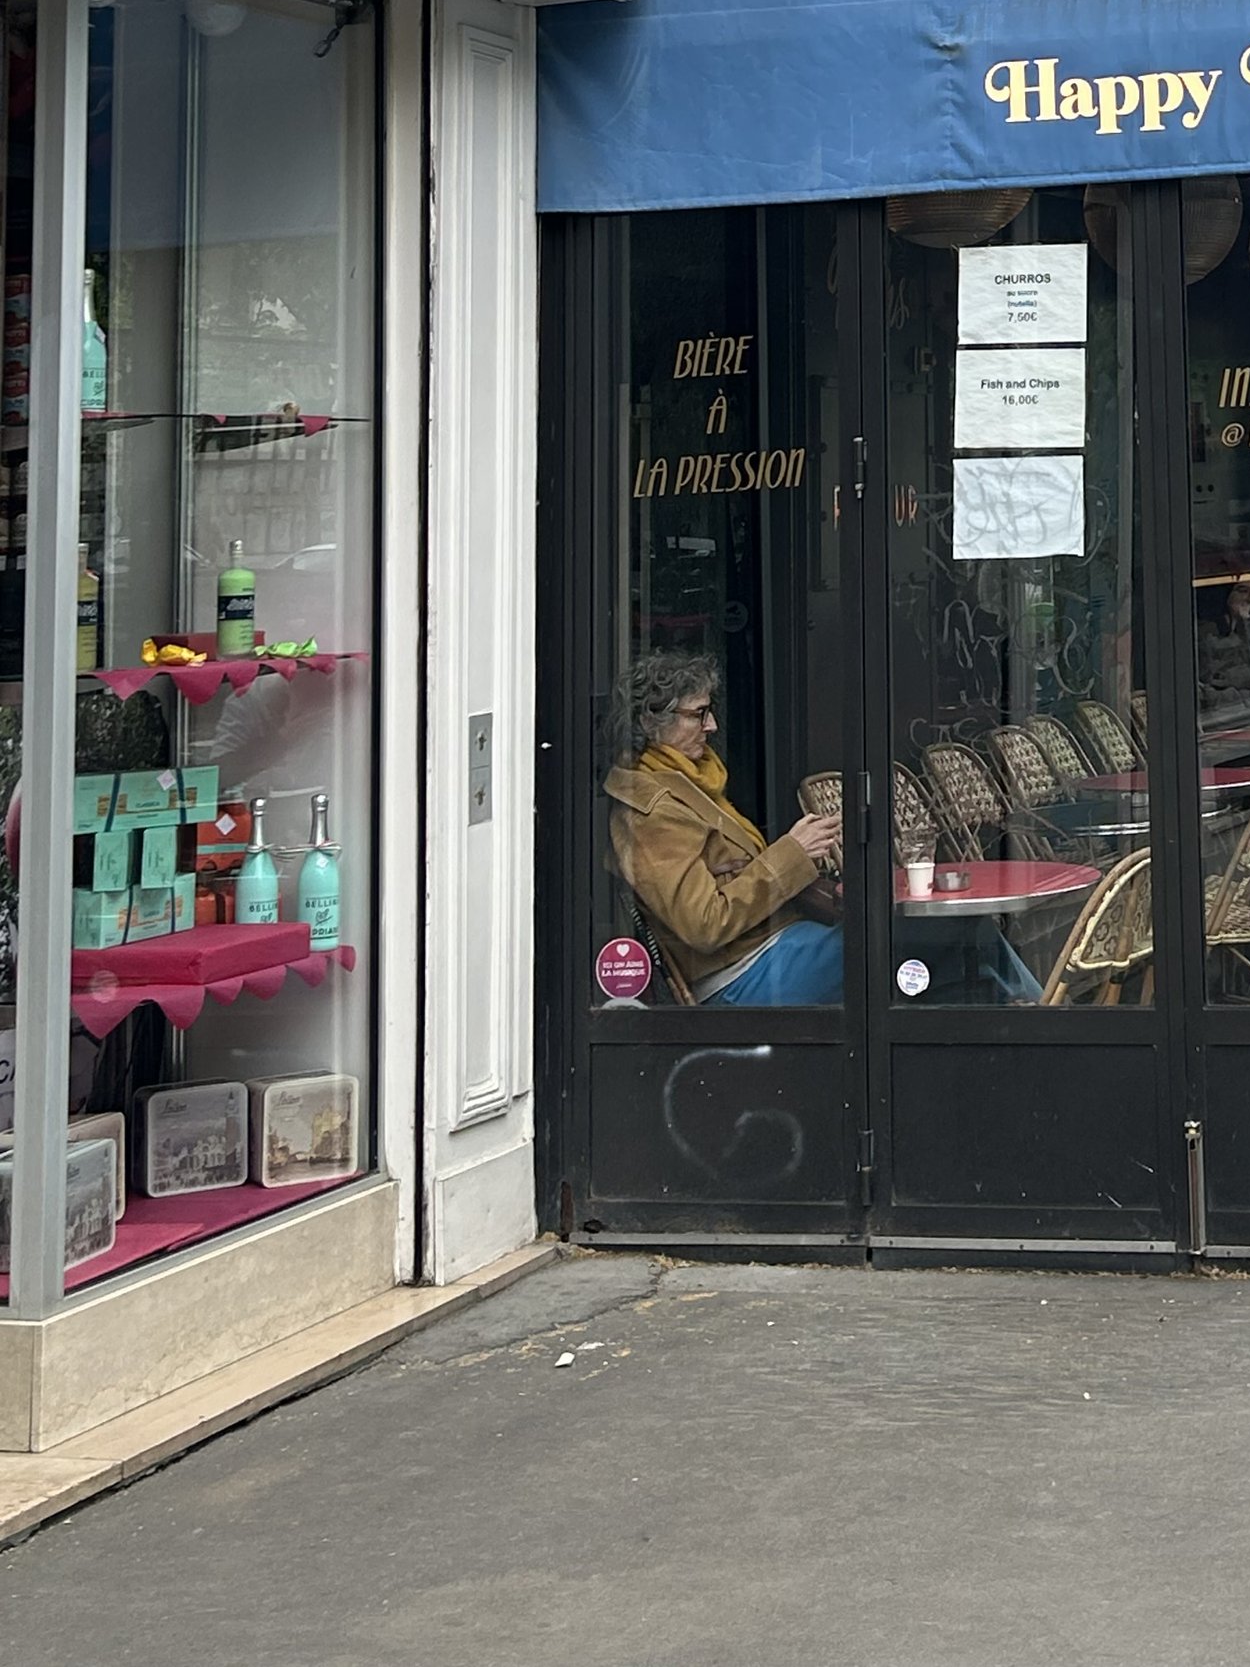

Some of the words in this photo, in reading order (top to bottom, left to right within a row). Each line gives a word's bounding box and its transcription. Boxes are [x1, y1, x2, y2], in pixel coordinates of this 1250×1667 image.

[984, 57, 1223, 135] Happy
[994, 272, 1052, 285] CHURROS
[1007, 311, 1038, 324] 7,50€
[673, 331, 754, 379] BIÈRE
[980, 379, 1004, 390] Fish
[1005, 379, 1027, 389] and
[1028, 378, 1061, 391] Chips
[706, 387, 728, 435] À
[1001, 394, 1040, 407] 16,00€
[633, 457, 669, 499] LA
[674, 447, 806, 496] PRESSION
